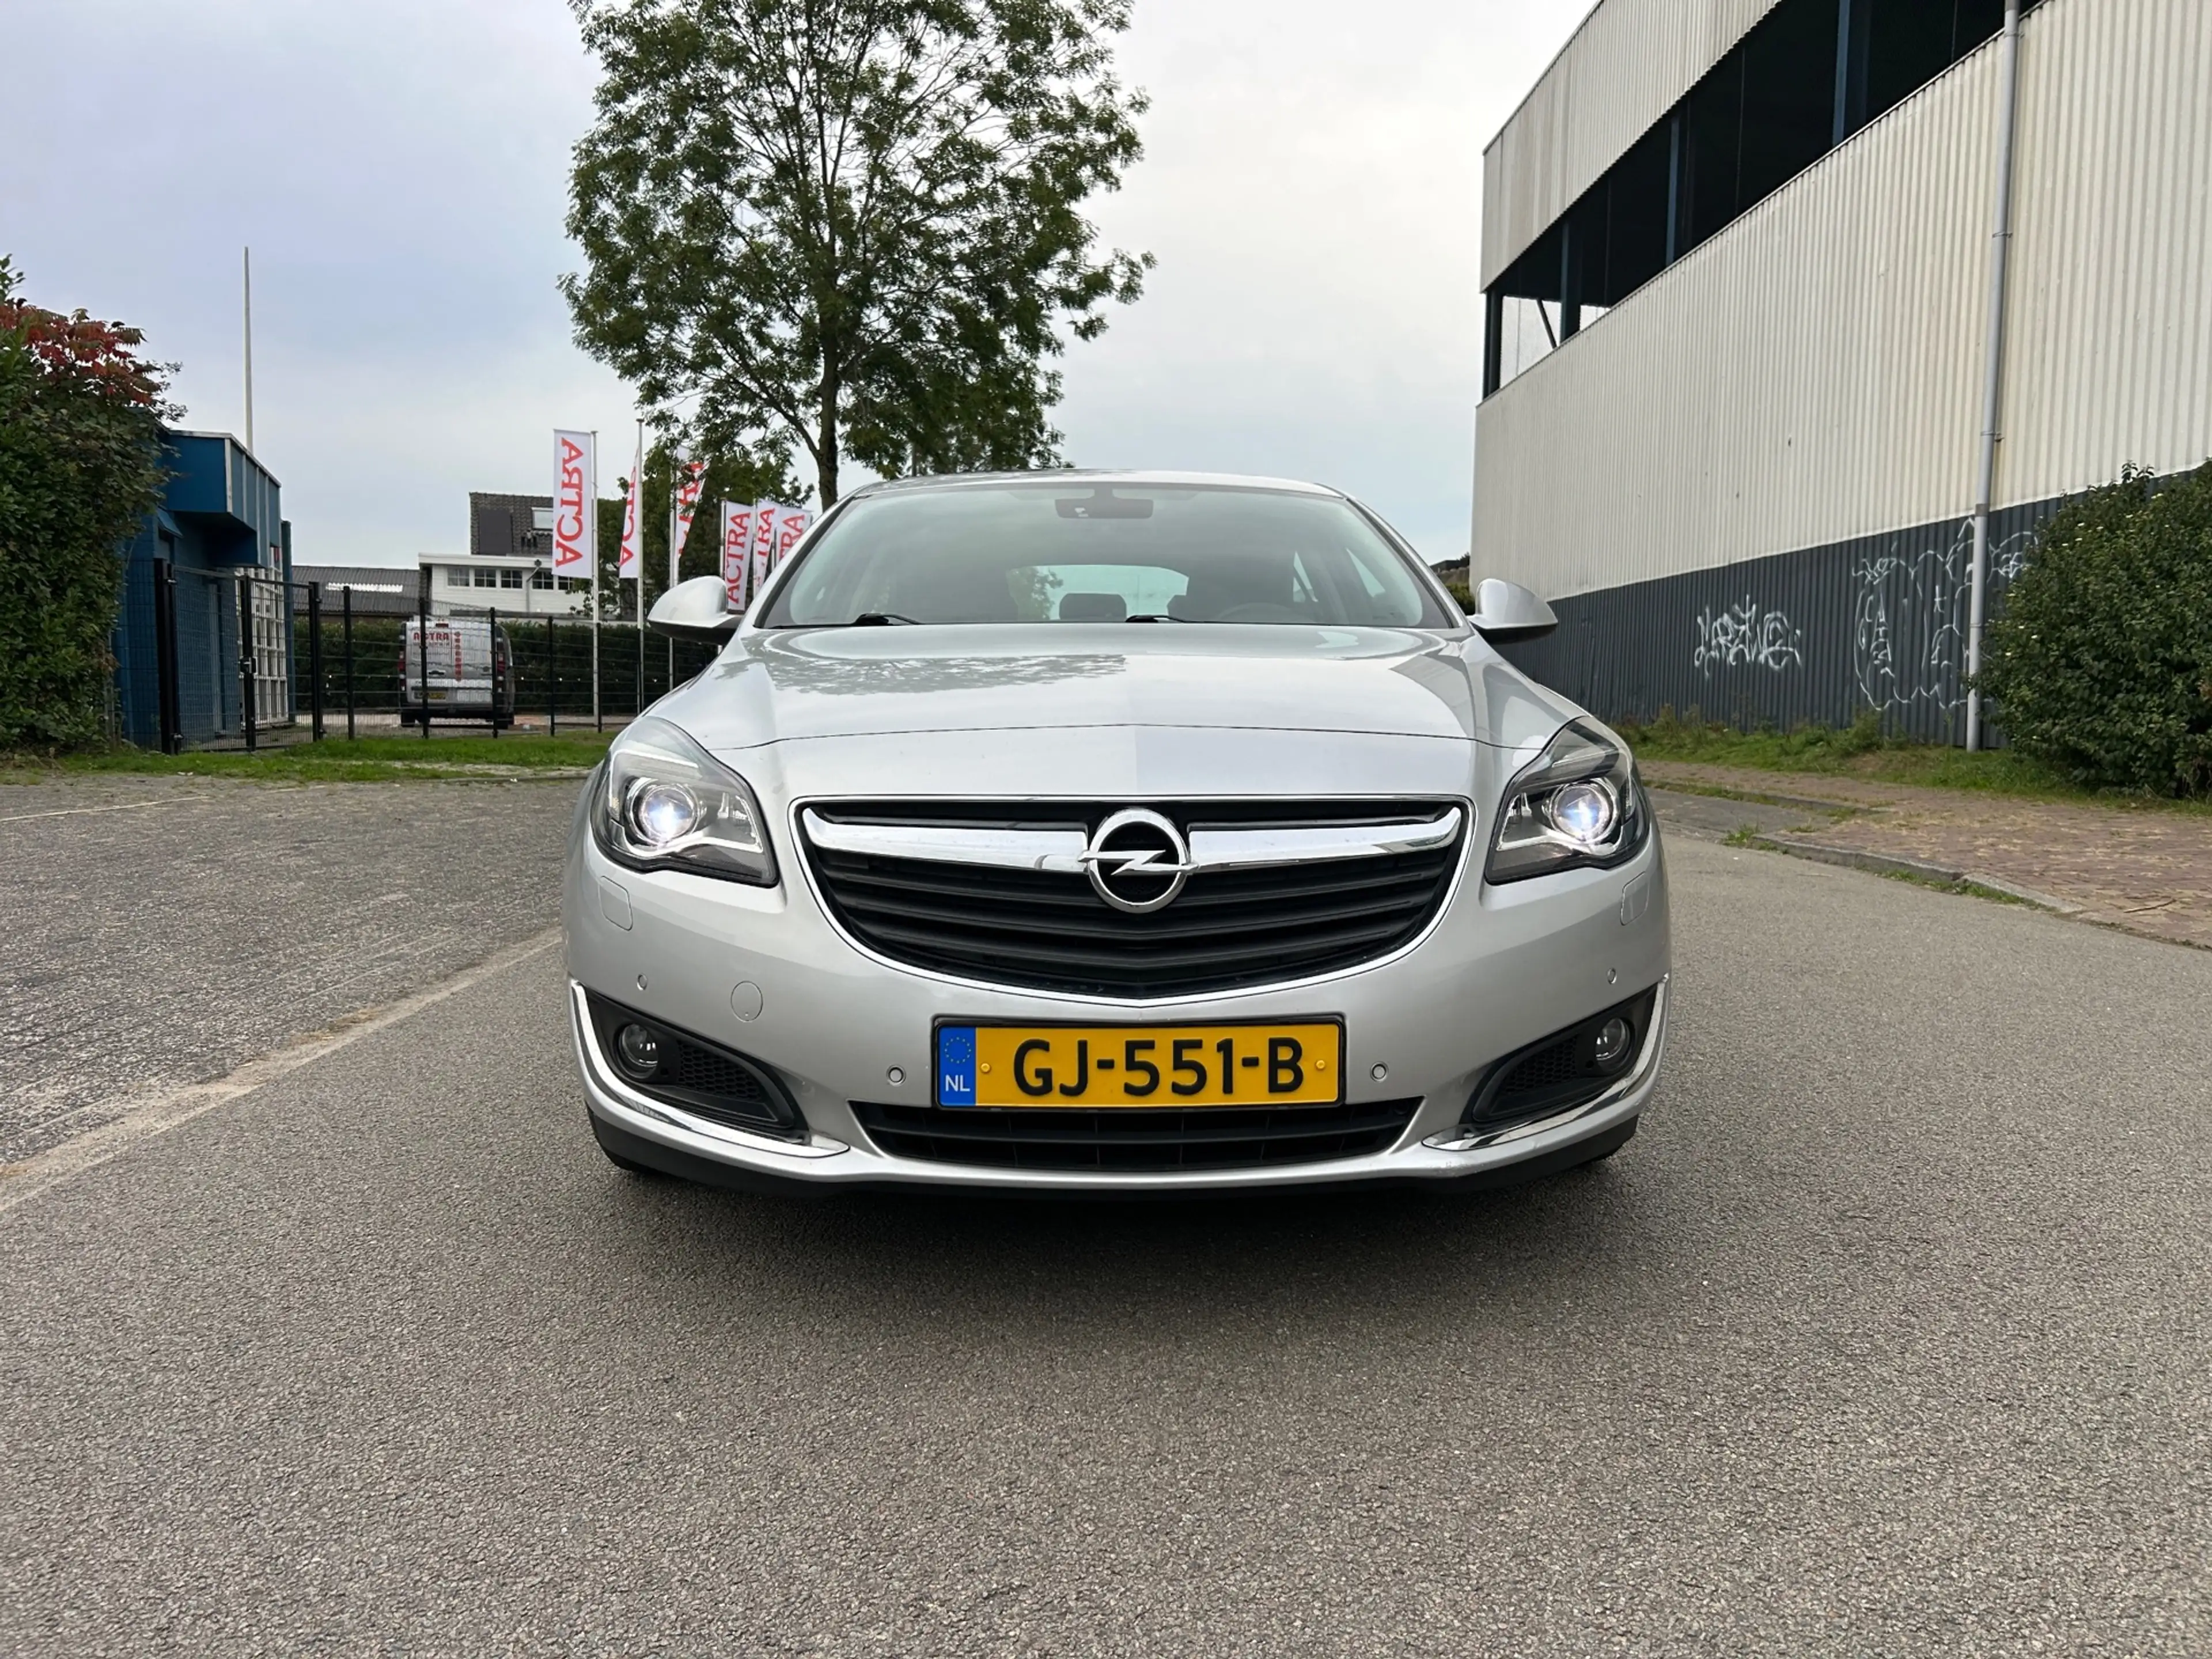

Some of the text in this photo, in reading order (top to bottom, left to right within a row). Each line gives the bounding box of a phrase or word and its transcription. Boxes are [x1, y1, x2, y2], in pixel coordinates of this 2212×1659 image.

[726, 512, 751, 604] ACTRA
[945, 1074, 971, 1092] NL
[1013, 1037, 1304, 1096] GJ-551-B
